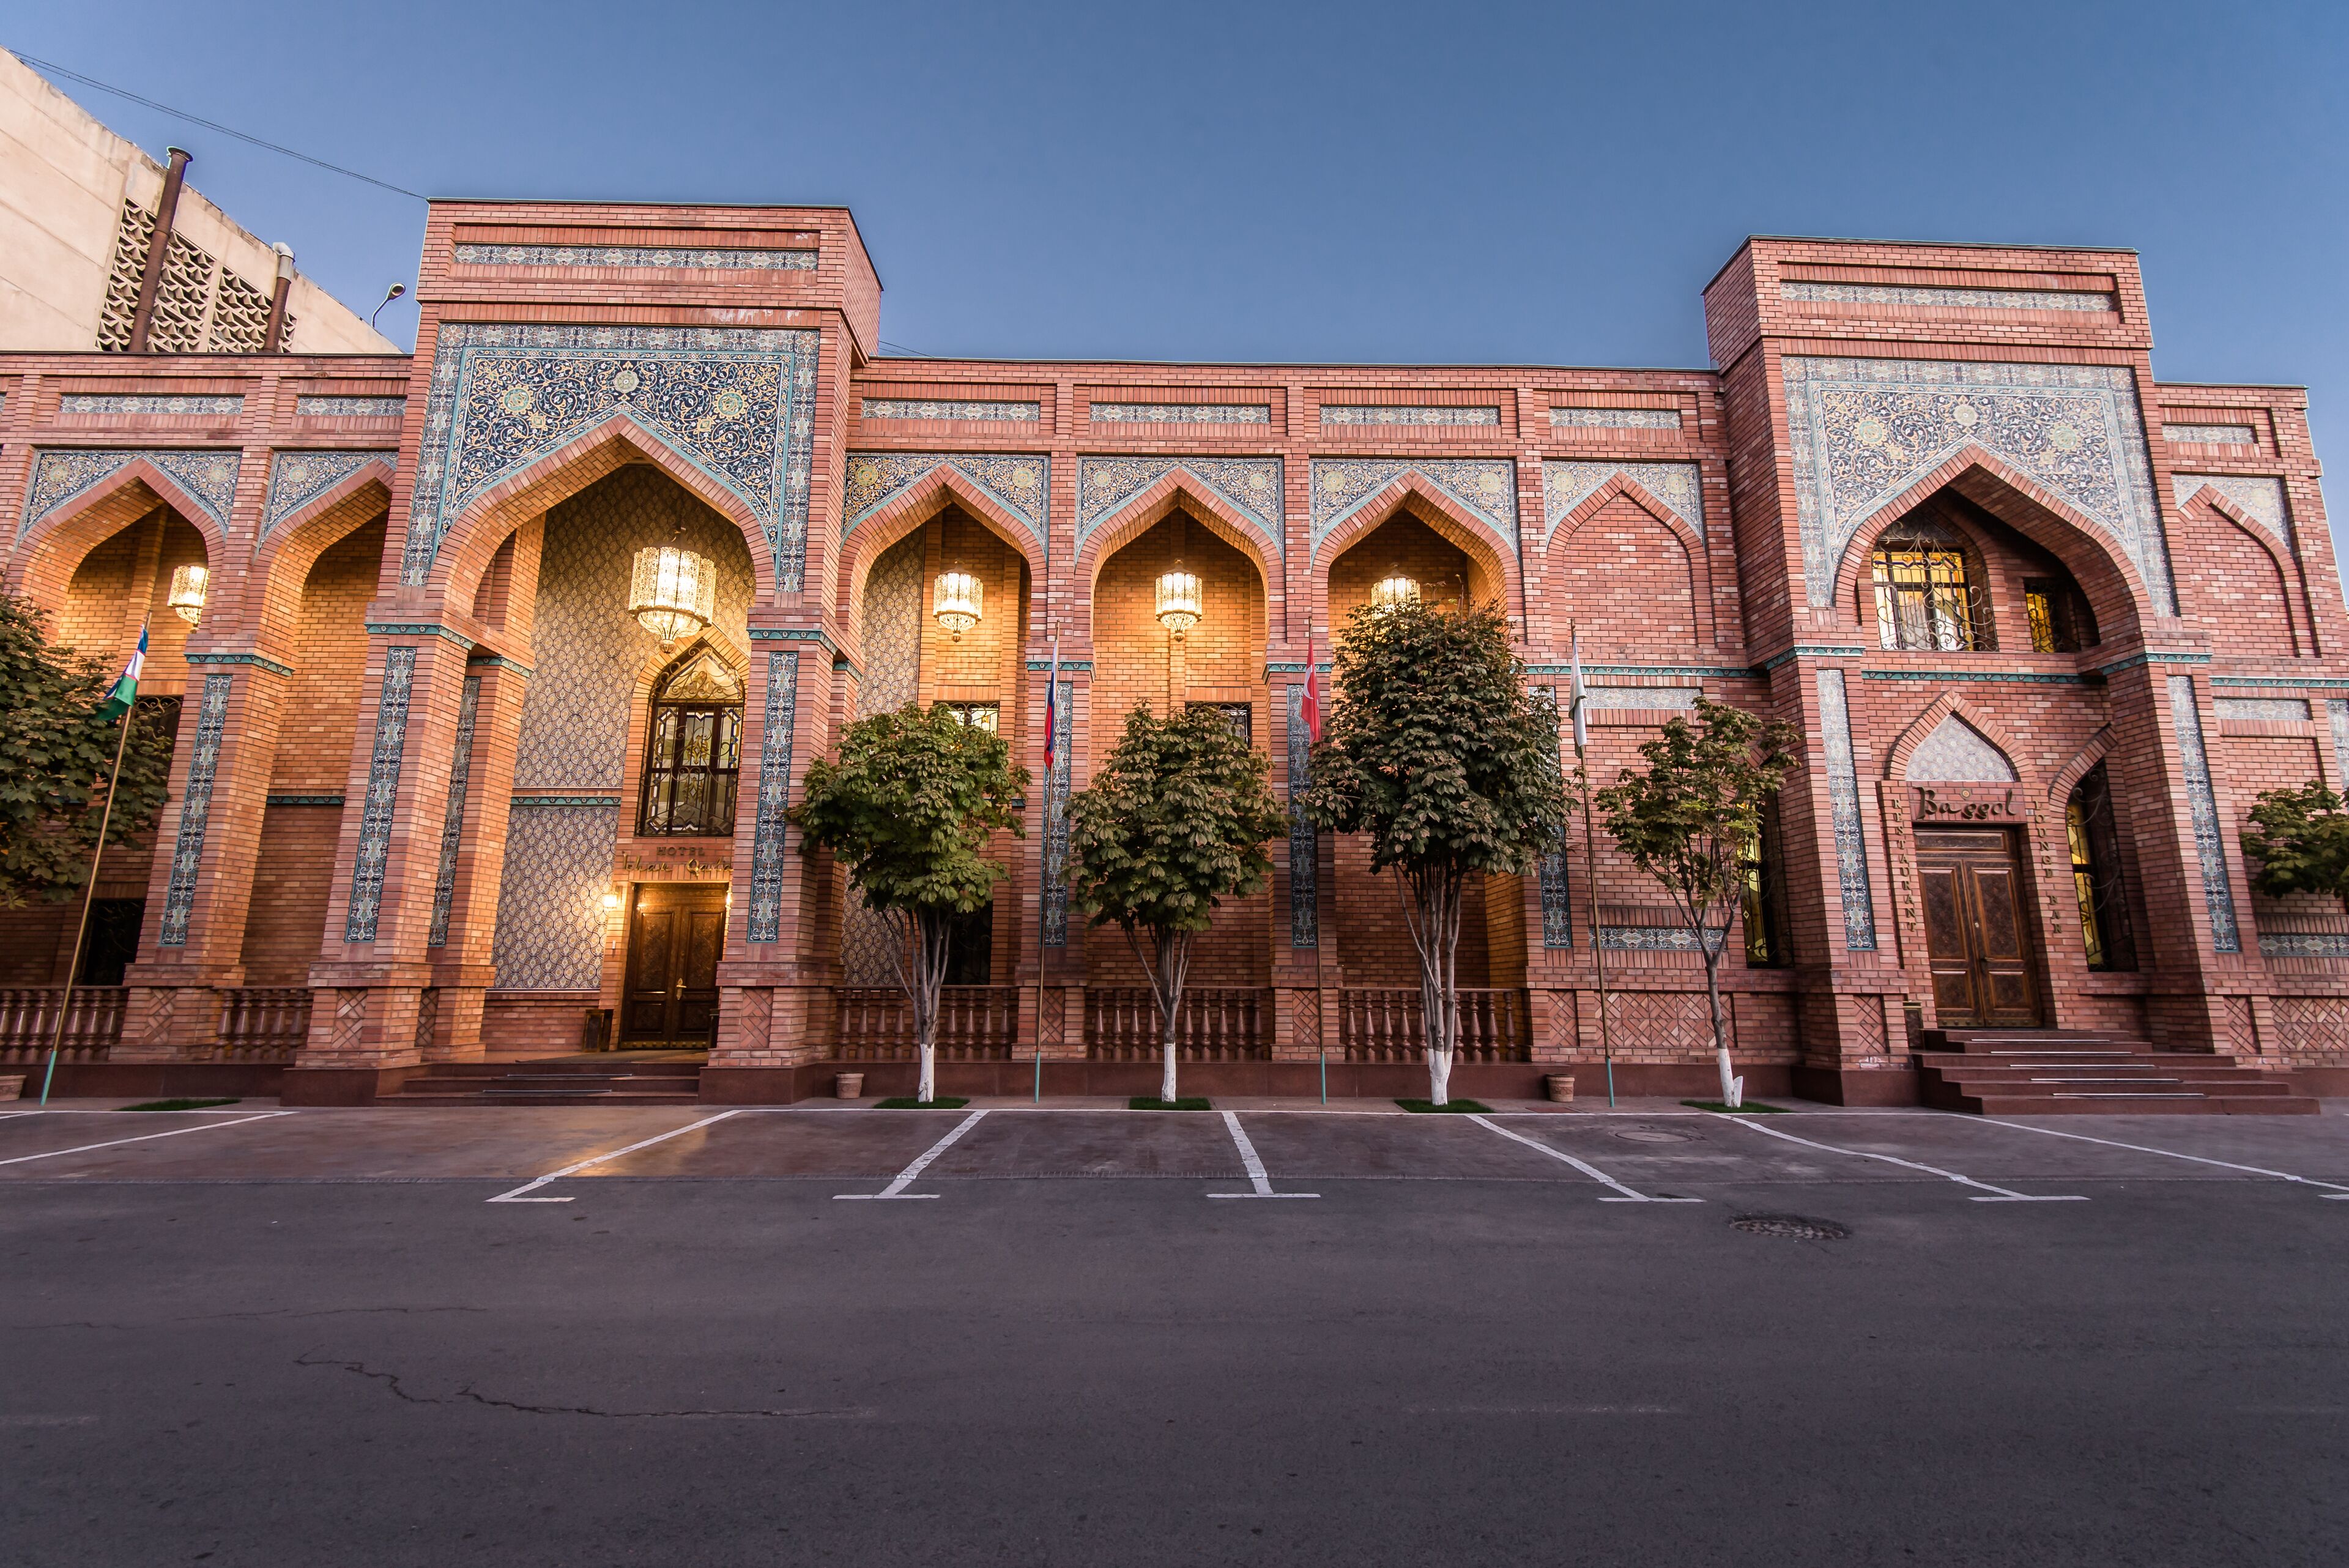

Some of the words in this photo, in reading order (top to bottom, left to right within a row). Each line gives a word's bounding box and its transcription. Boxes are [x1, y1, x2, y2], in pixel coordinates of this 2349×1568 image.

[656, 847, 705, 855] HOTEL
[1894, 799, 1916, 932] RESTAURANT
[2034, 801, 2053, 877] LOUNGE
[2049, 895, 2062, 933] BAR
